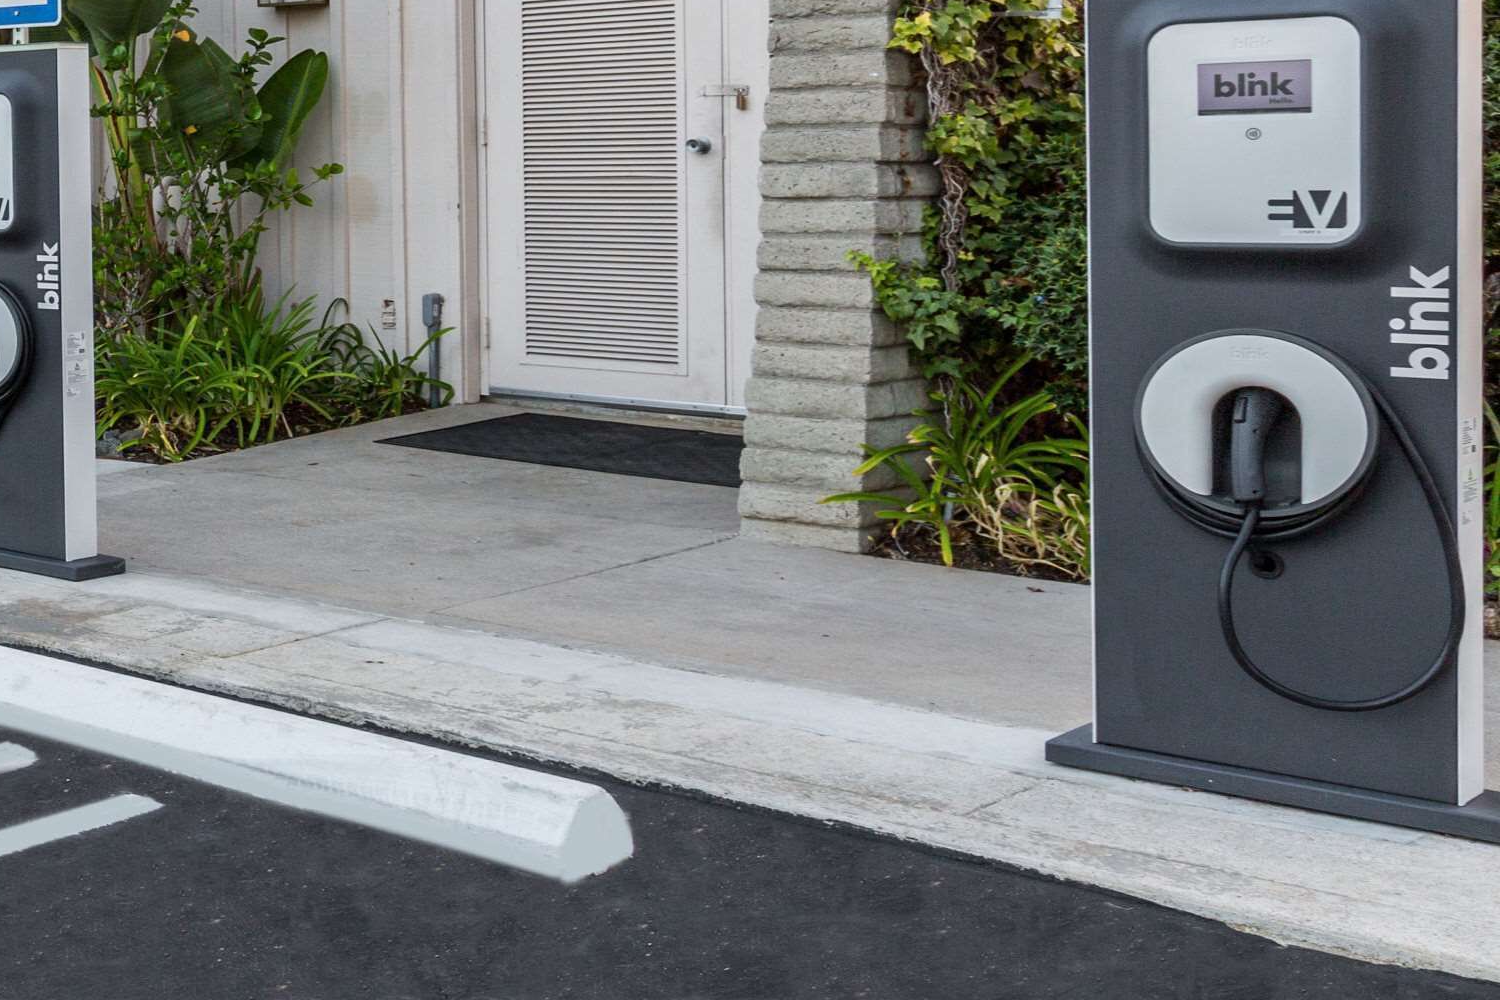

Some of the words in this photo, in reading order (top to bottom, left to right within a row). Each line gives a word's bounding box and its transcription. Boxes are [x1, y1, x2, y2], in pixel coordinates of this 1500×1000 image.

[1213, 71, 1294, 99] blink
[36, 241, 60, 310] blink
[1388, 264, 1450, 380] blink
